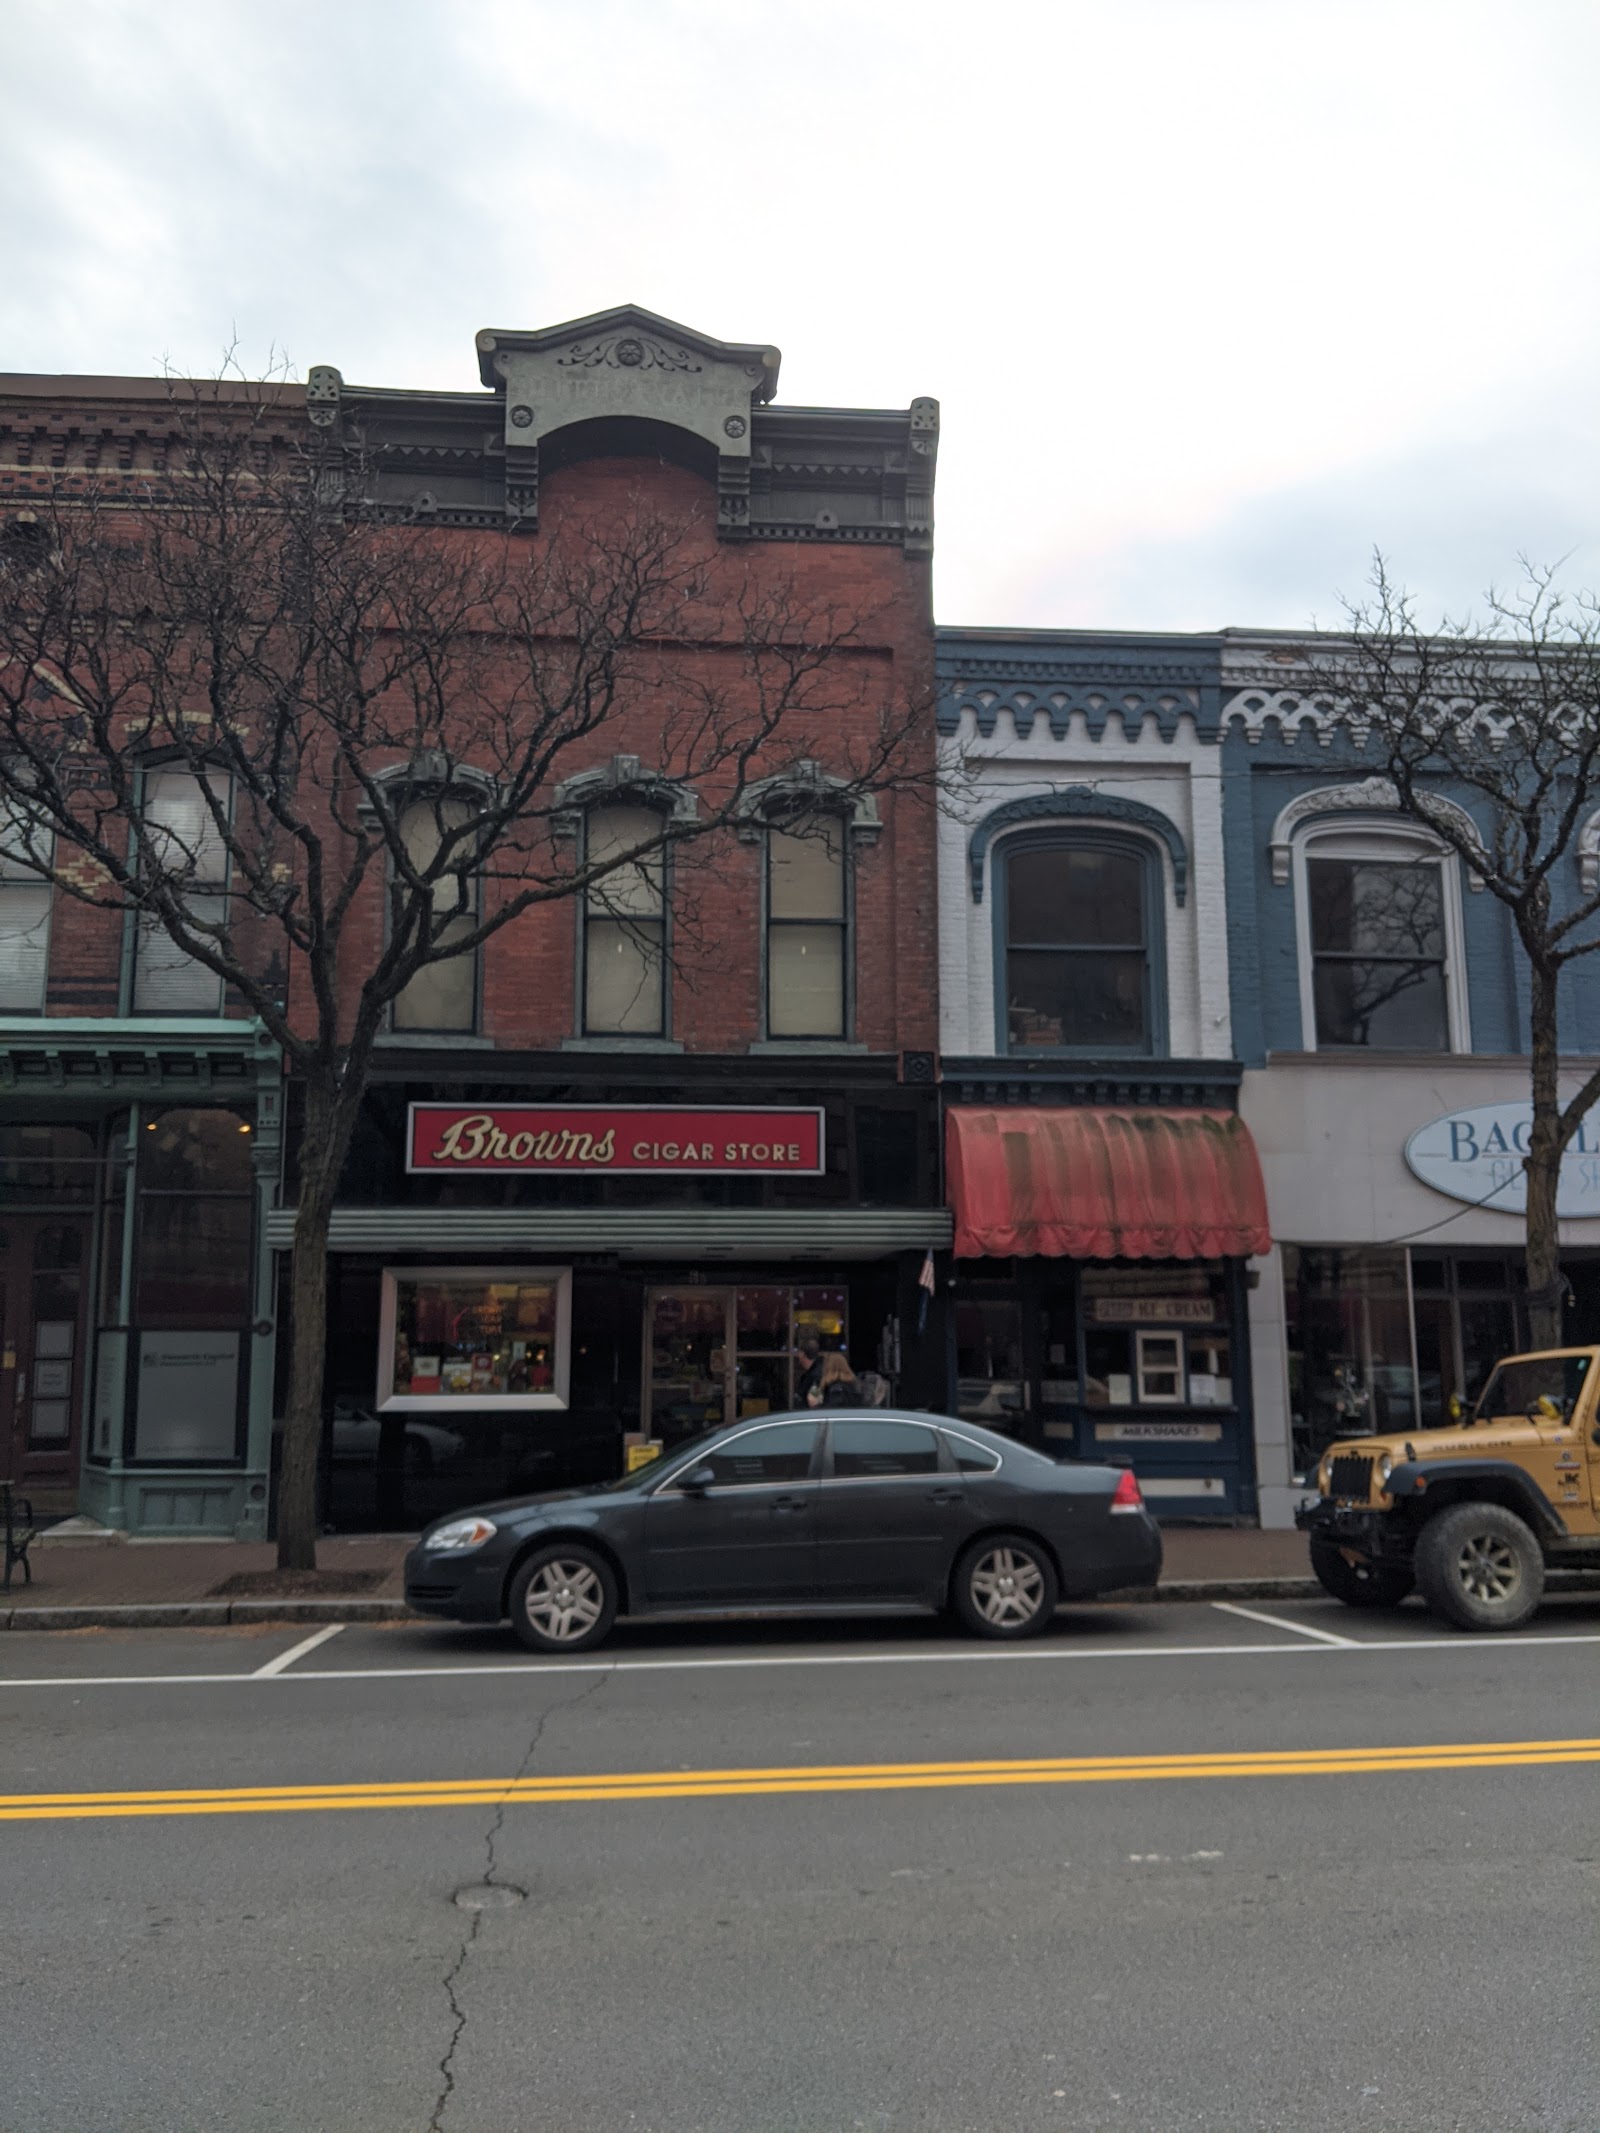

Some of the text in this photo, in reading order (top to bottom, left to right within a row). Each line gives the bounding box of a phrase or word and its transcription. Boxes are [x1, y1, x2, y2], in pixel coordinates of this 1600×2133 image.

[432, 1114, 801, 1163] Browns CIGAR STORE
[1121, 1425, 1199, 1436] MILKSHAKES
